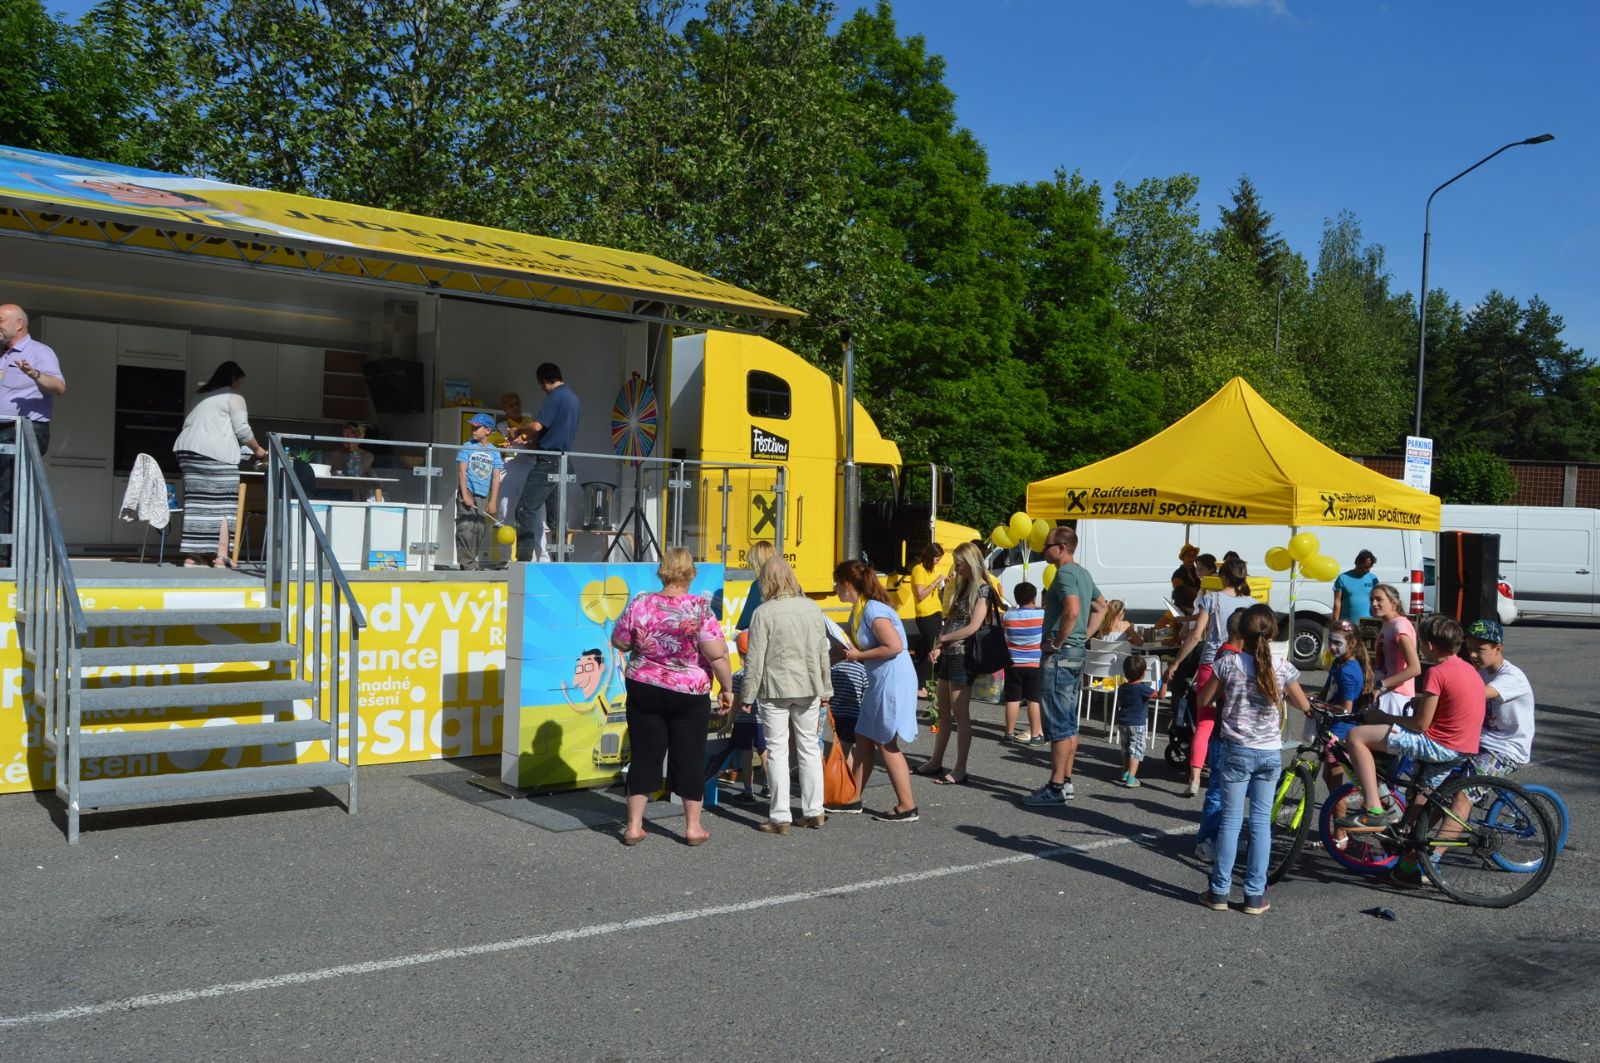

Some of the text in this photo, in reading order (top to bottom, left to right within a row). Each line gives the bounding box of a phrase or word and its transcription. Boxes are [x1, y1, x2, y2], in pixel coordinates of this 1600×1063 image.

[753, 428, 788, 454] Festival
[1407, 440, 1432, 449] PARKING
[1091, 486, 1157, 498] Raiffeisen
[1334, 493, 1377, 504] Raiffeisen
[1091, 499, 1249, 519] STAVEBNÍ SPOŘITELNA
[1339, 505, 1422, 526] STAVEBNÍ SPOŘITELNA
[357, 692, 401, 707] ešení
